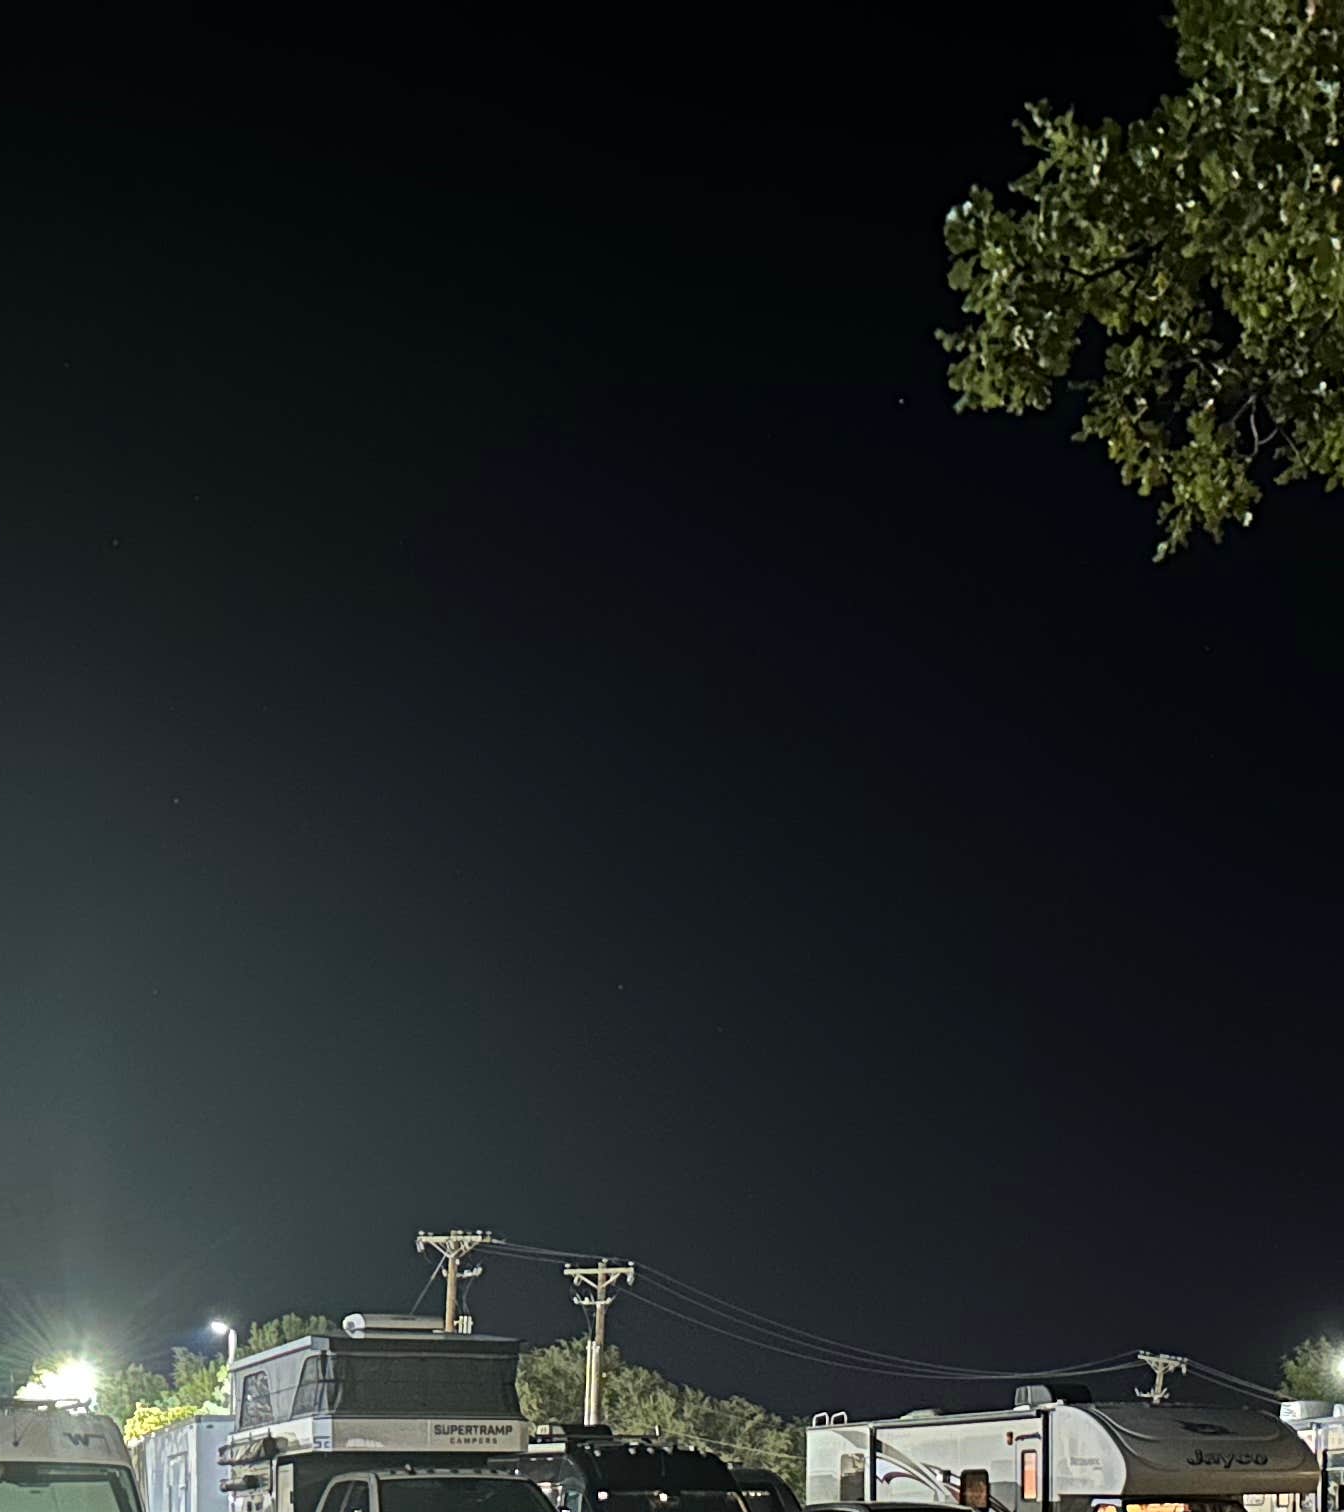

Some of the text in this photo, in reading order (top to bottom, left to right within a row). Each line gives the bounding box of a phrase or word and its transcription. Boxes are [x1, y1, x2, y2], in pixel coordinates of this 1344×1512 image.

[434, 1424, 513, 1436] SUPERTRAMP
[449, 1437, 498, 1445] CAMPERS
[1186, 1448, 1269, 1469] Jayco
